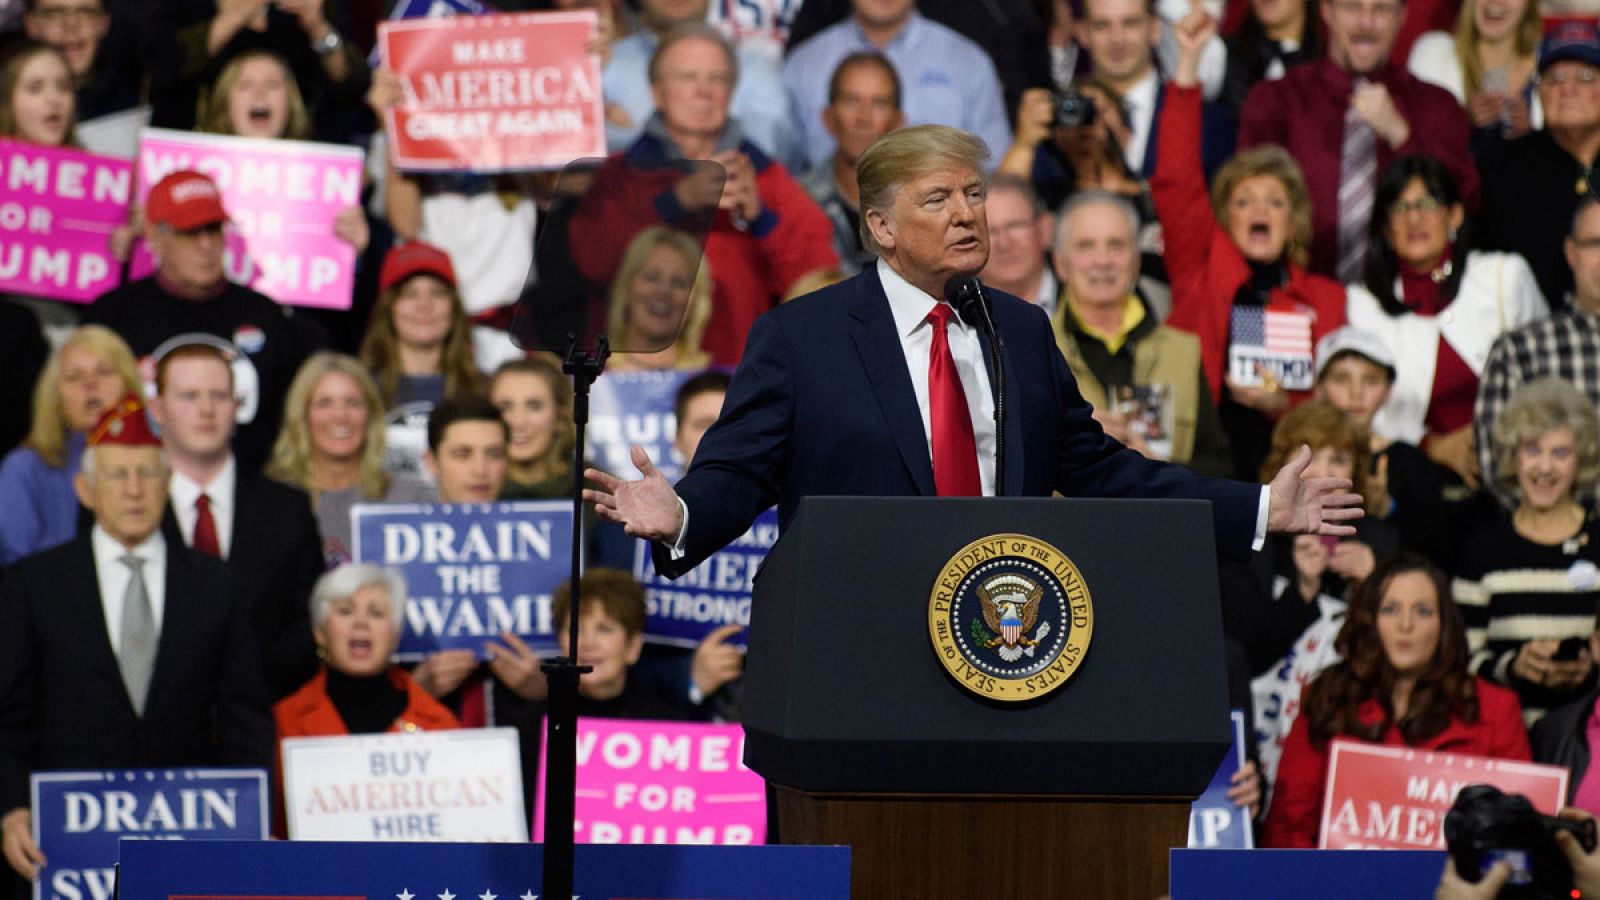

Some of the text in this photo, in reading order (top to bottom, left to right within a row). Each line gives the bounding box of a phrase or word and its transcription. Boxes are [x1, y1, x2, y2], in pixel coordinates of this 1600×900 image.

[452, 37, 524, 64] MAKE
[401, 65, 595, 112] AMERICA
[406, 108, 584, 140] GREAT AGAIN
[0, 152, 131, 205] MEN
[384, 519, 551, 564] DRAIN
[437, 563, 501, 594] THE
[405, 594, 554, 637] WAM
[935, 540, 1088, 693] SEAL OF THE PRESIDENT OF THE UNITED STATES
[369, 750, 432, 777] BUY
[64, 788, 237, 833] DRAIN
[306, 775, 504, 815] AMERICAN
[614, 783, 697, 813] FOR
[372, 813, 442, 838] HIRE
[574, 820, 754, 845] RUMP
